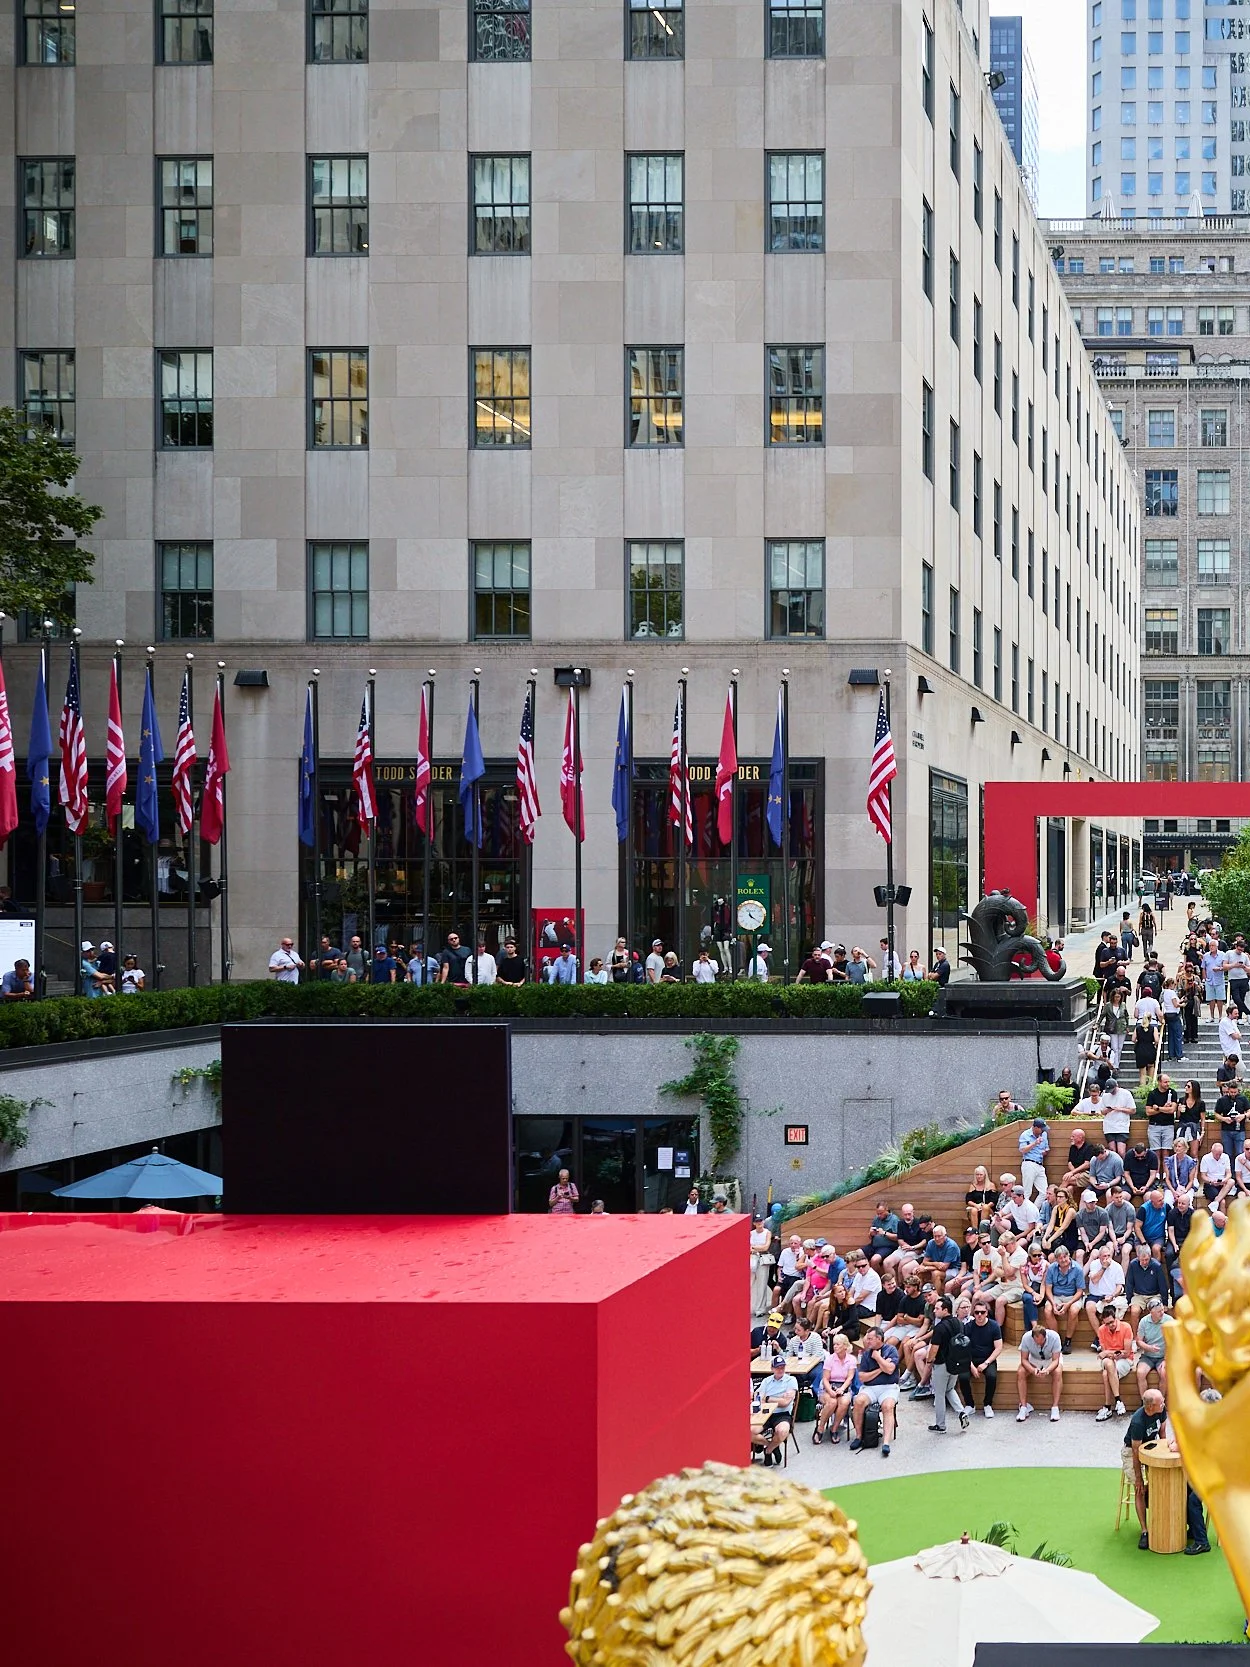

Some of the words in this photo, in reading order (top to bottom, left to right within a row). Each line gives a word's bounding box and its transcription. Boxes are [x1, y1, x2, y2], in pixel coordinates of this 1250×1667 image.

[376, 766, 404, 780] TODD
[409, 766, 452, 780] SDER
[689, 766, 711, 780] ODD
[789, 1128, 805, 1141] EXIT
